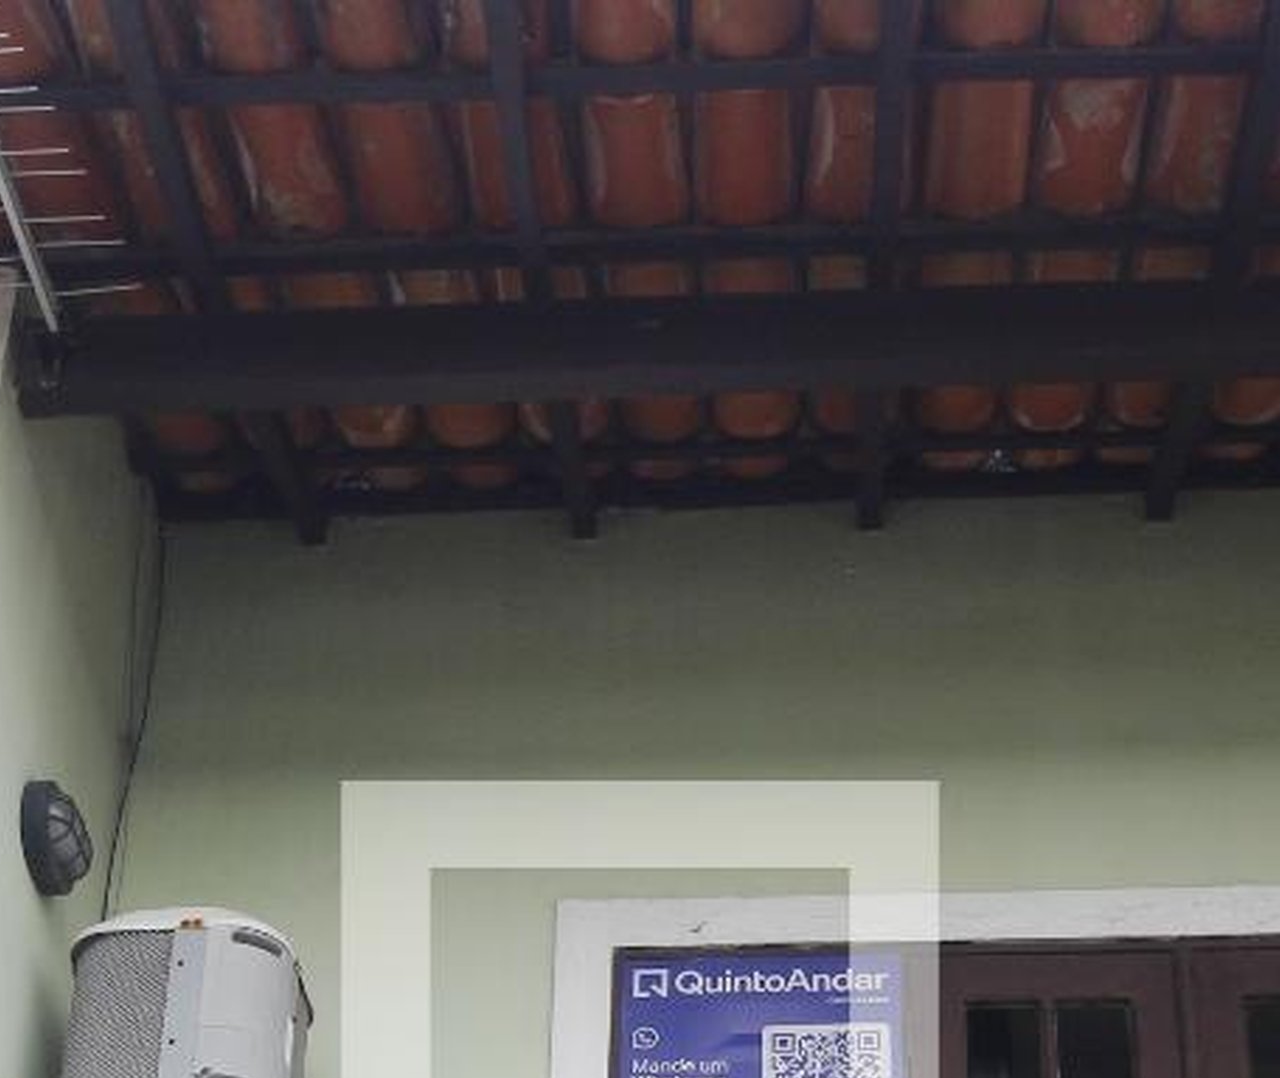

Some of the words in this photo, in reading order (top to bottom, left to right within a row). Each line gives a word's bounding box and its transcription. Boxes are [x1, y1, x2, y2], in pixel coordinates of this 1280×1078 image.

[674, 969, 888, 995] QuintoAndar
[631, 1059, 696, 1074] Mande
[699, 1061, 731, 1074] um
